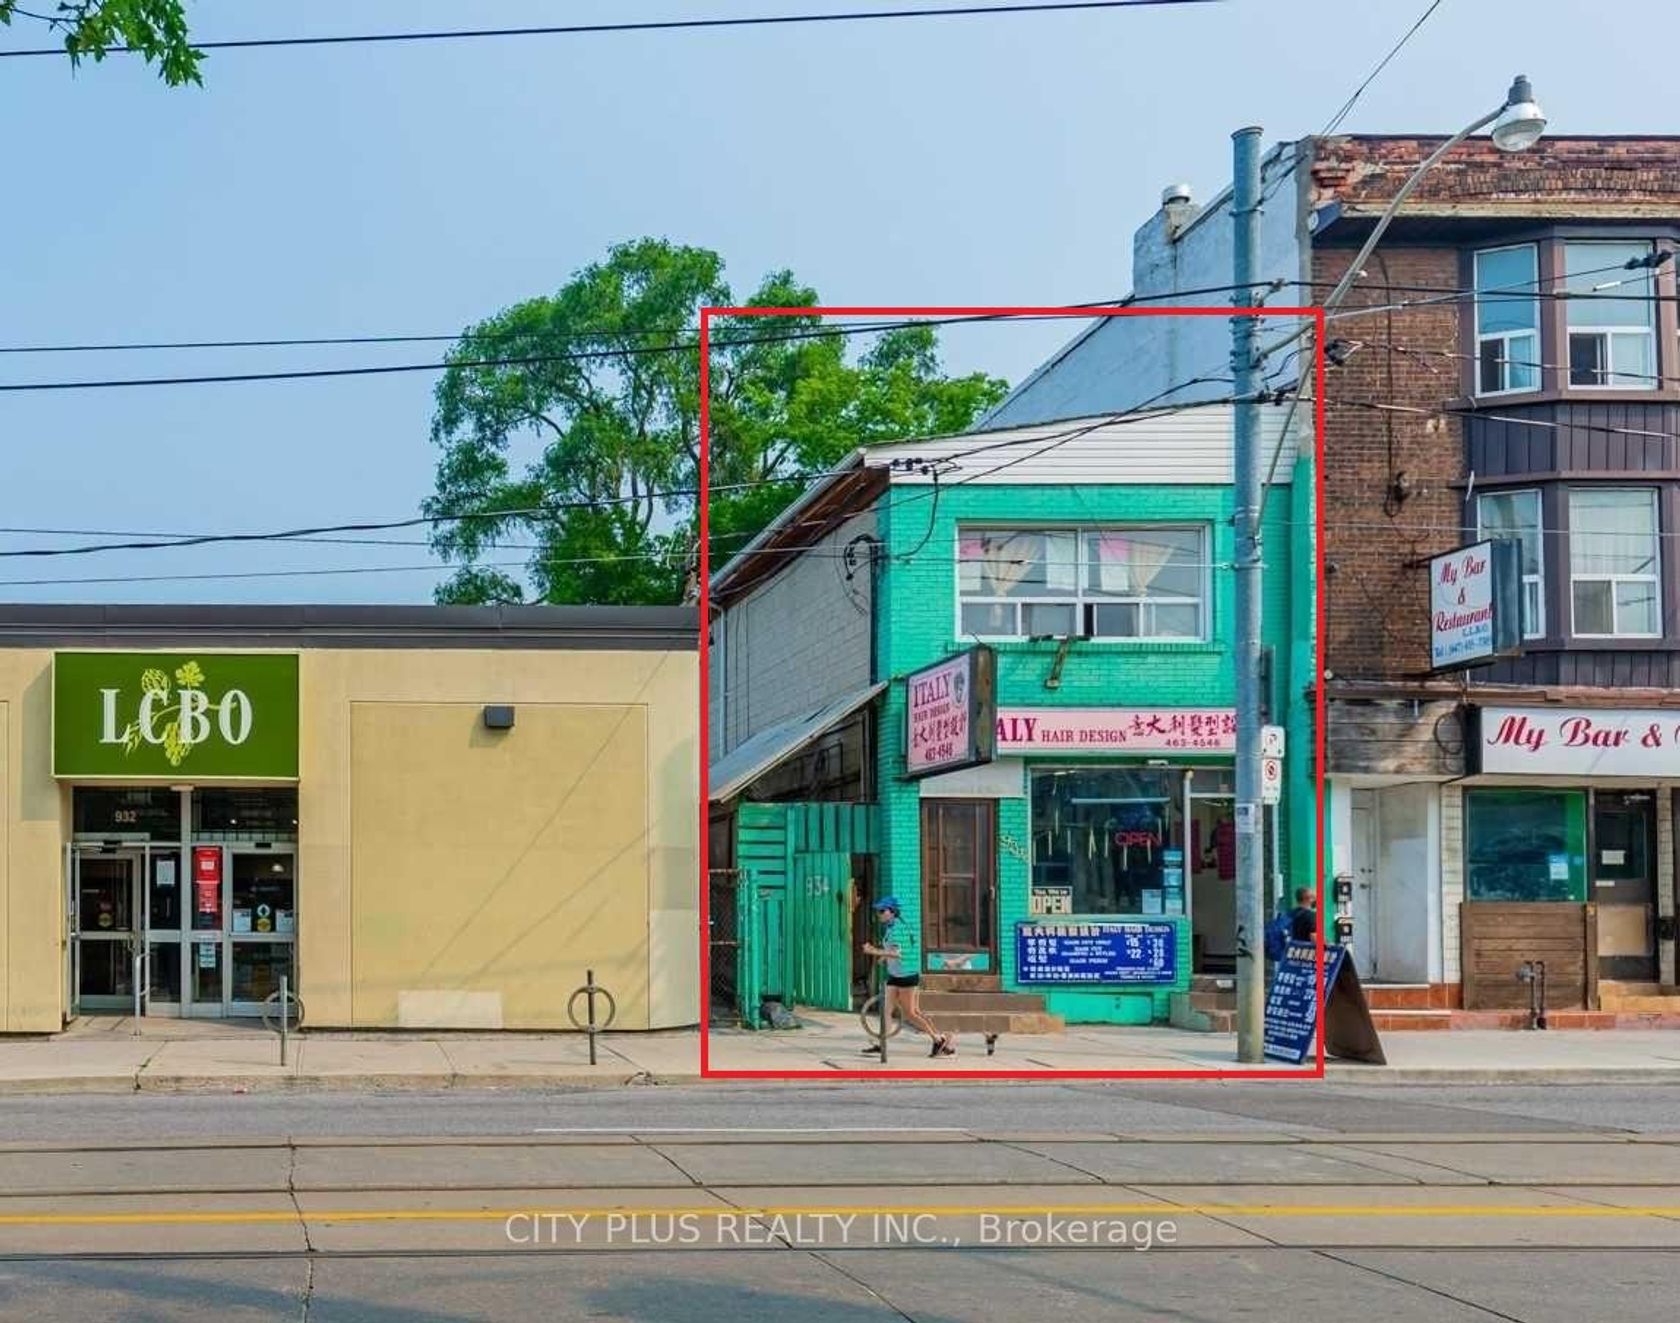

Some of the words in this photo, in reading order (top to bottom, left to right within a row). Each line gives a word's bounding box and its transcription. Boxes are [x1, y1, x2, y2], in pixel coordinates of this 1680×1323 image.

[1437, 561, 1457, 586] My
[1461, 555, 1486, 579] Bar
[1457, 586, 1466, 605] &
[1433, 602, 1493, 632] Restaurant
[913, 671, 951, 708] ITALY
[99, 688, 253, 746] LCBO
[996, 717, 1038, 743] ALY
[1041, 729, 1074, 743] HAIR
[1079, 729, 1127, 743] DESIGN
[1487, 715, 1547, 753] My
[1558, 715, 1630, 748] Bar
[1641, 722, 1663, 748] &
[114, 810, 137, 822] 932
[1114, 831, 1162, 847] OPEN
[1031, 895, 1072, 914] OPEN
